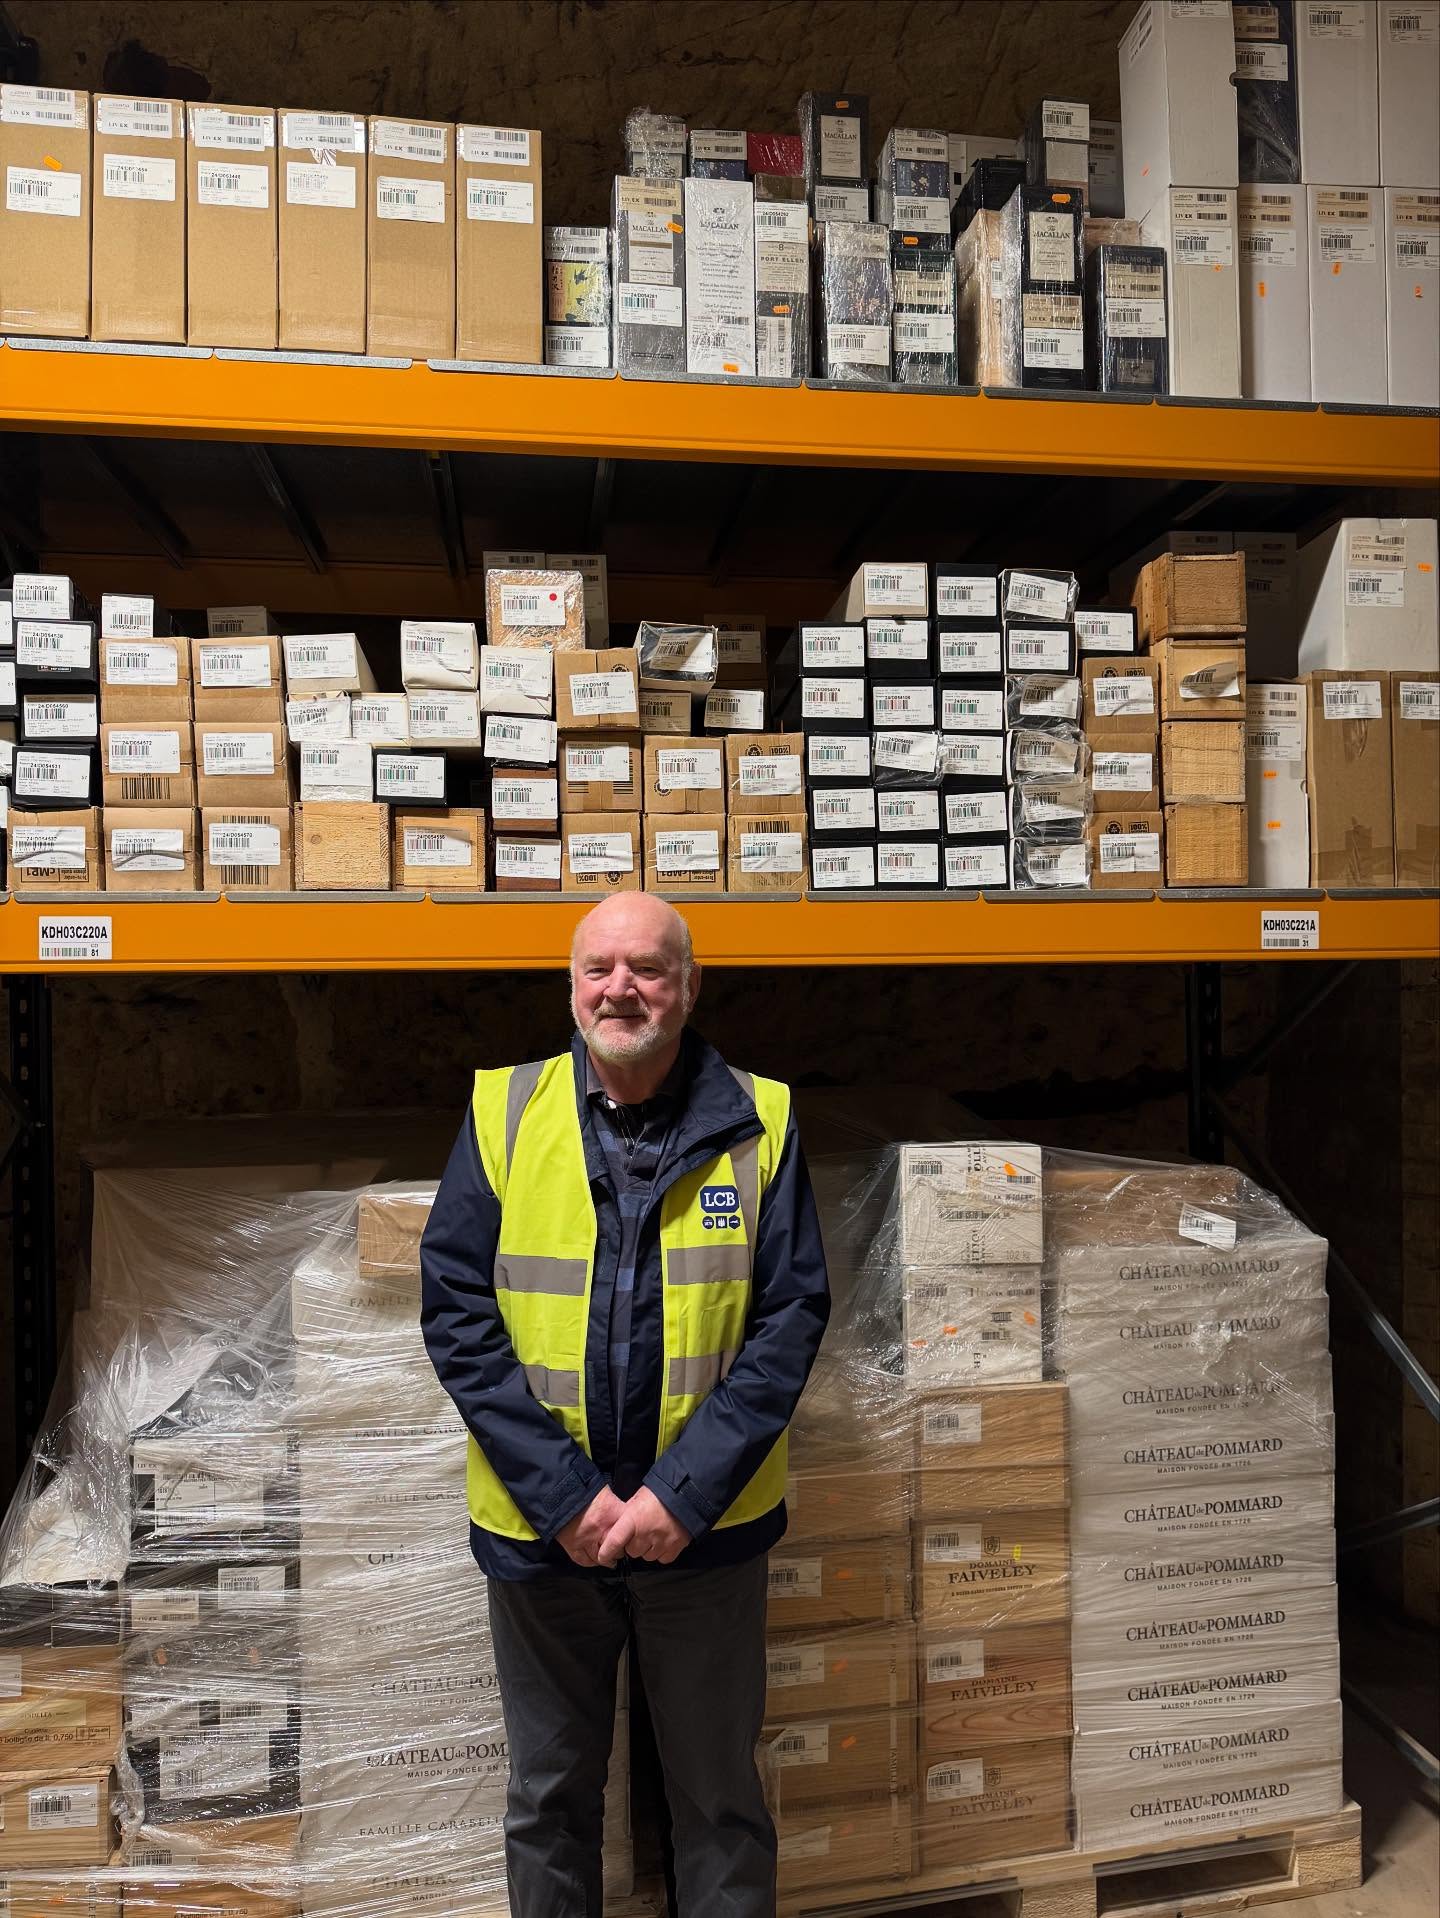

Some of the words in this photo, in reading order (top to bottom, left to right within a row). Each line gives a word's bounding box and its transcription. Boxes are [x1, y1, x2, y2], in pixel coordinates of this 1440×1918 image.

[823, 132, 857, 140] MACALLAN
[632, 225, 669, 233] MACALLAN
[26, 867, 55, 877] cMP1
[41, 926, 108, 938] KDH03C220A
[1263, 920, 1315, 930] KDH03C221A
[703, 1191, 735, 1206] LCB
[1119, 1262, 1192, 1280] CHÂTEAU
[1201, 1260, 1279, 1276] POMMARD
[1119, 1321, 1192, 1340] CHÂTEAU
[1122, 1386, 1195, 1405] CHÂTEAU
[1187, 1404, 1216, 1412] FONDÉE
[1123, 1445, 1196, 1464] CHÂTEAU
[1204, 1438, 1283, 1457] POMMARD
[1189, 1463, 1218, 1471] FONDÉE
[1124, 1504, 1196, 1523] CHÂTEAU
[1204, 1495, 1283, 1515] POMMARD
[1189, 1520, 1218, 1529] FONDÉE
[969, 1558, 1015, 1569] DOMAINE
[1124, 1562, 1196, 1582] CHÂTEAU
[1204, 1554, 1284, 1573] POMMARD
[947, 1564, 1036, 1584] FAIVELEY
[1189, 1579, 1218, 1587] FONDÉE
[1126, 1622, 1199, 1641] CHÂTEAU
[1206, 1610, 1286, 1632] POMMARD
[1191, 1637, 1221, 1646] FONDÉE
[971, 1676, 1017, 1686] DOMAINE
[1127, 1682, 1200, 1701] CHÂTEAU
[1208, 1669, 1287, 1692] POMMARD
[950, 1681, 1037, 1701] FAIVELEY
[1193, 1697, 1222, 1705] FONDÉE
[1129, 1740, 1201, 1760] CHÂTEAU
[1210, 1728, 1289, 1750] POMMARD
[1163, 1760, 1192, 1769] MAISON
[1195, 1756, 1224, 1765] FONDÉE
[407, 1770, 443, 1779] MAISON
[949, 1797, 1033, 1816] FAIVELEY
[1130, 1798, 1202, 1818] CHÂTEAU
[1211, 1783, 1290, 1806] POMMARD
[1164, 1816, 1193, 1826] MAISON
[1196, 1812, 1225, 1822] FONDÉE
[359, 1823, 422, 1837] FAMILLE
